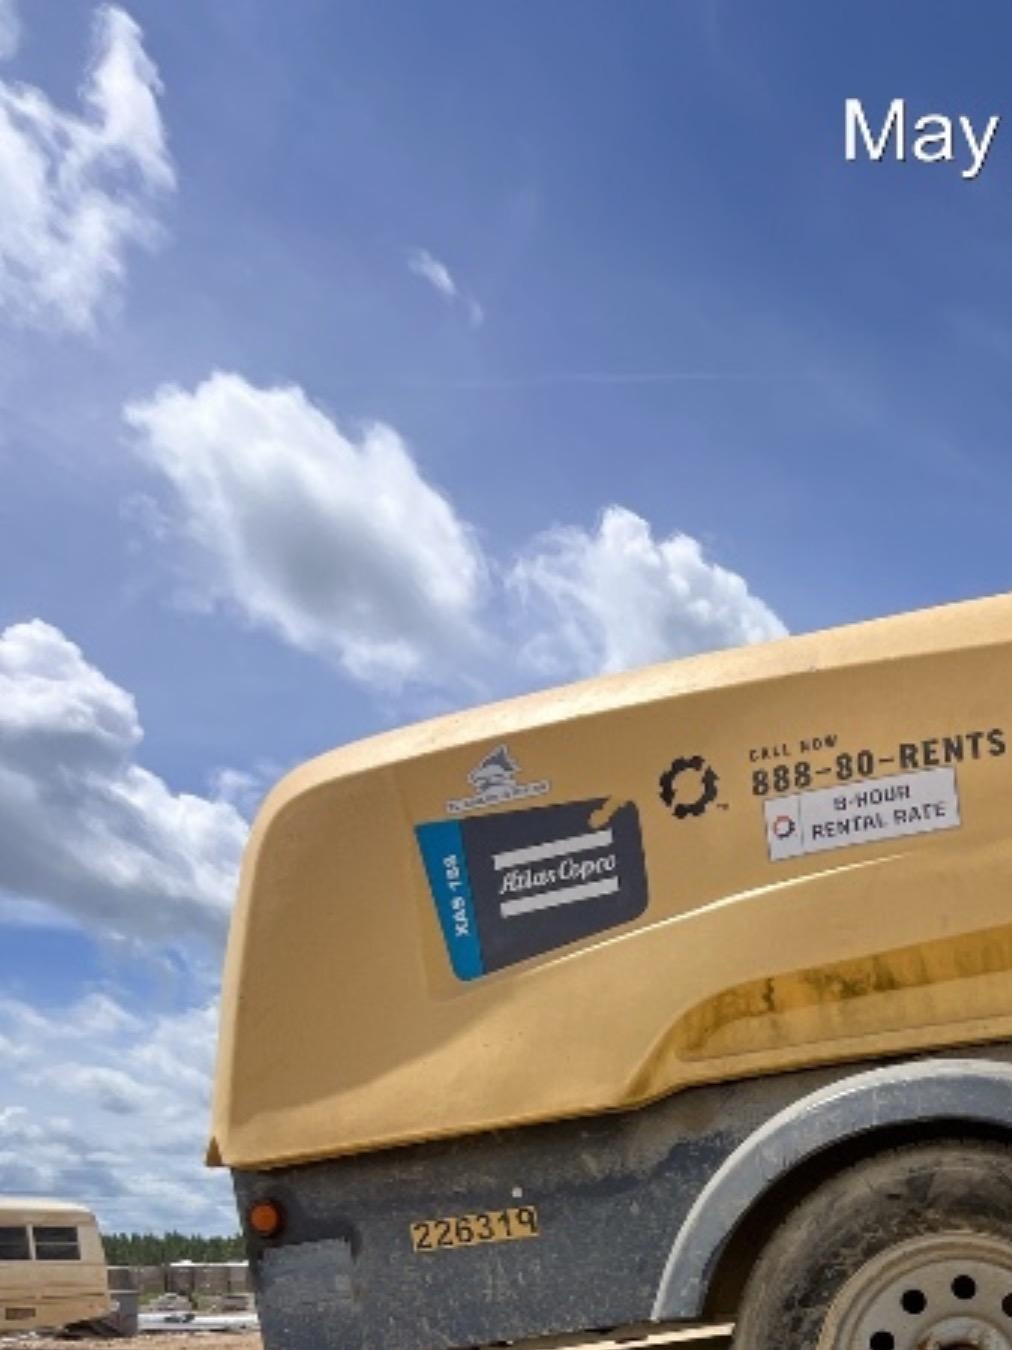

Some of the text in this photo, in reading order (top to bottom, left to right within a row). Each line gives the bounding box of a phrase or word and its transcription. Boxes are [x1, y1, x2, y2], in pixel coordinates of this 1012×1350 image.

[749, 743, 791, 762] CALL
[752, 728, 1006, 796] 888-80-RENTS
[812, 801, 947, 840] RENTAL RATE
[499, 853, 617, 895] Atlas Copco
[413, 1206, 538, 1250] 226319
